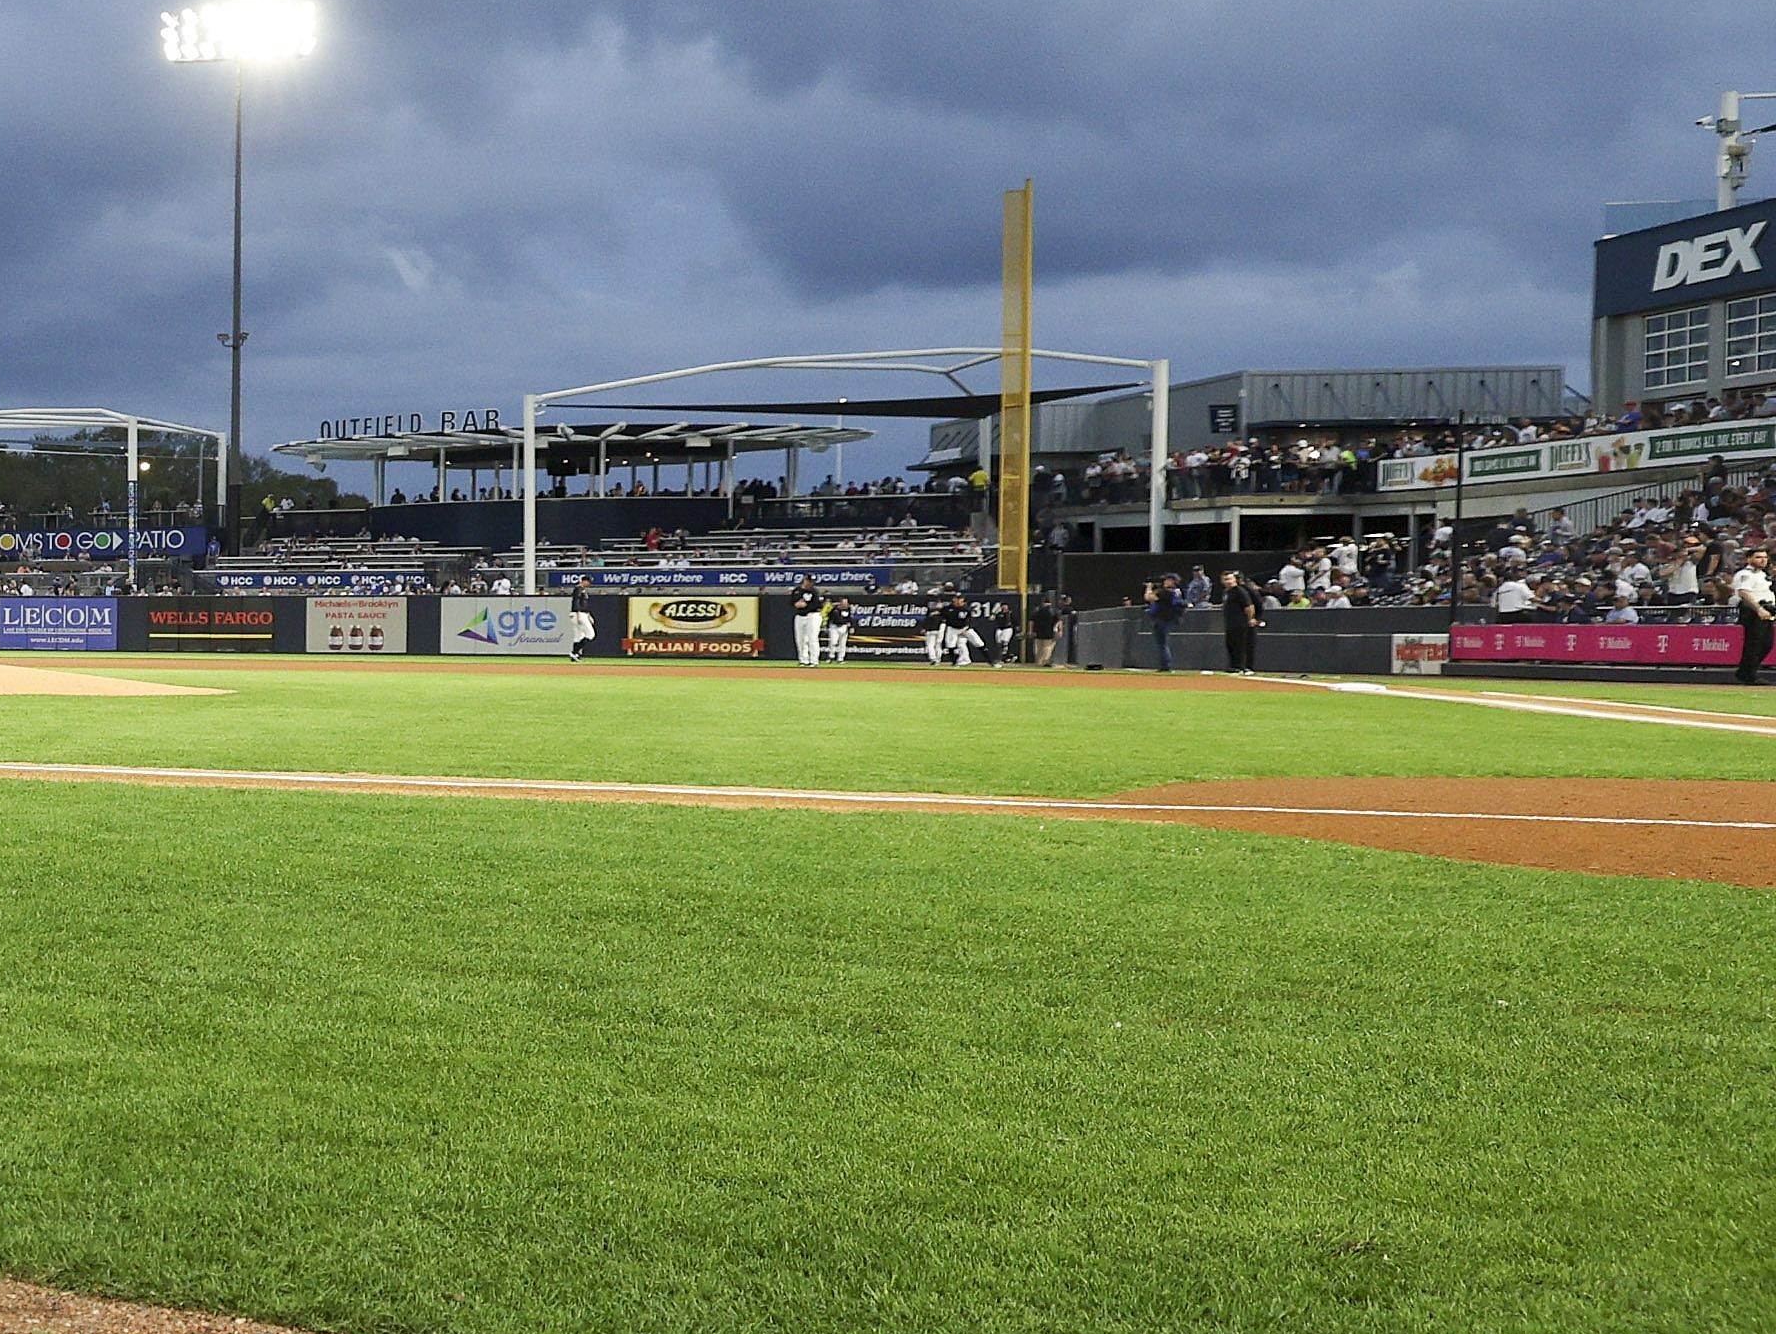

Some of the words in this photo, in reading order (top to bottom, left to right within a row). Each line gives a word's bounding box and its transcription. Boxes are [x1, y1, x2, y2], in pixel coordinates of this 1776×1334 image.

[1652, 220, 1768, 292] DEX
[320, 413, 422, 439] OUTFIELD
[441, 409, 500, 433] BAR
[46, 532, 72, 550] TO
[76, 531, 112, 550] GO
[231, 576, 254, 586] HCC
[274, 576, 297, 586] HCC
[318, 576, 341, 585] HCC
[602, 573, 629, 583] We'll
[630, 574, 648, 585] get
[649, 575, 670, 585] you
[672, 573, 704, 583] there
[719, 573, 748, 584] HCC
[764, 572, 794, 583] We'll
[358, 600, 399, 609] Brooklyn
[664, 603, 721, 617] ALESSI
[850, 604, 875, 615] Your
[876, 604, 902, 615] First
[903, 603, 928, 615] Line
[149, 611, 209, 625] WELLS
[214, 611, 273, 625] FARGO
[325, 611, 354, 620] PASTA
[357, 612, 388, 620] SAUCE
[498, 606, 557, 638] gte
[858, 617, 871, 627] of
[871, 617, 917, 628] Defense
[509, 632, 564, 646] financial
[632, 641, 694, 652] ITALIAN
[699, 641, 752, 653] FOODS
